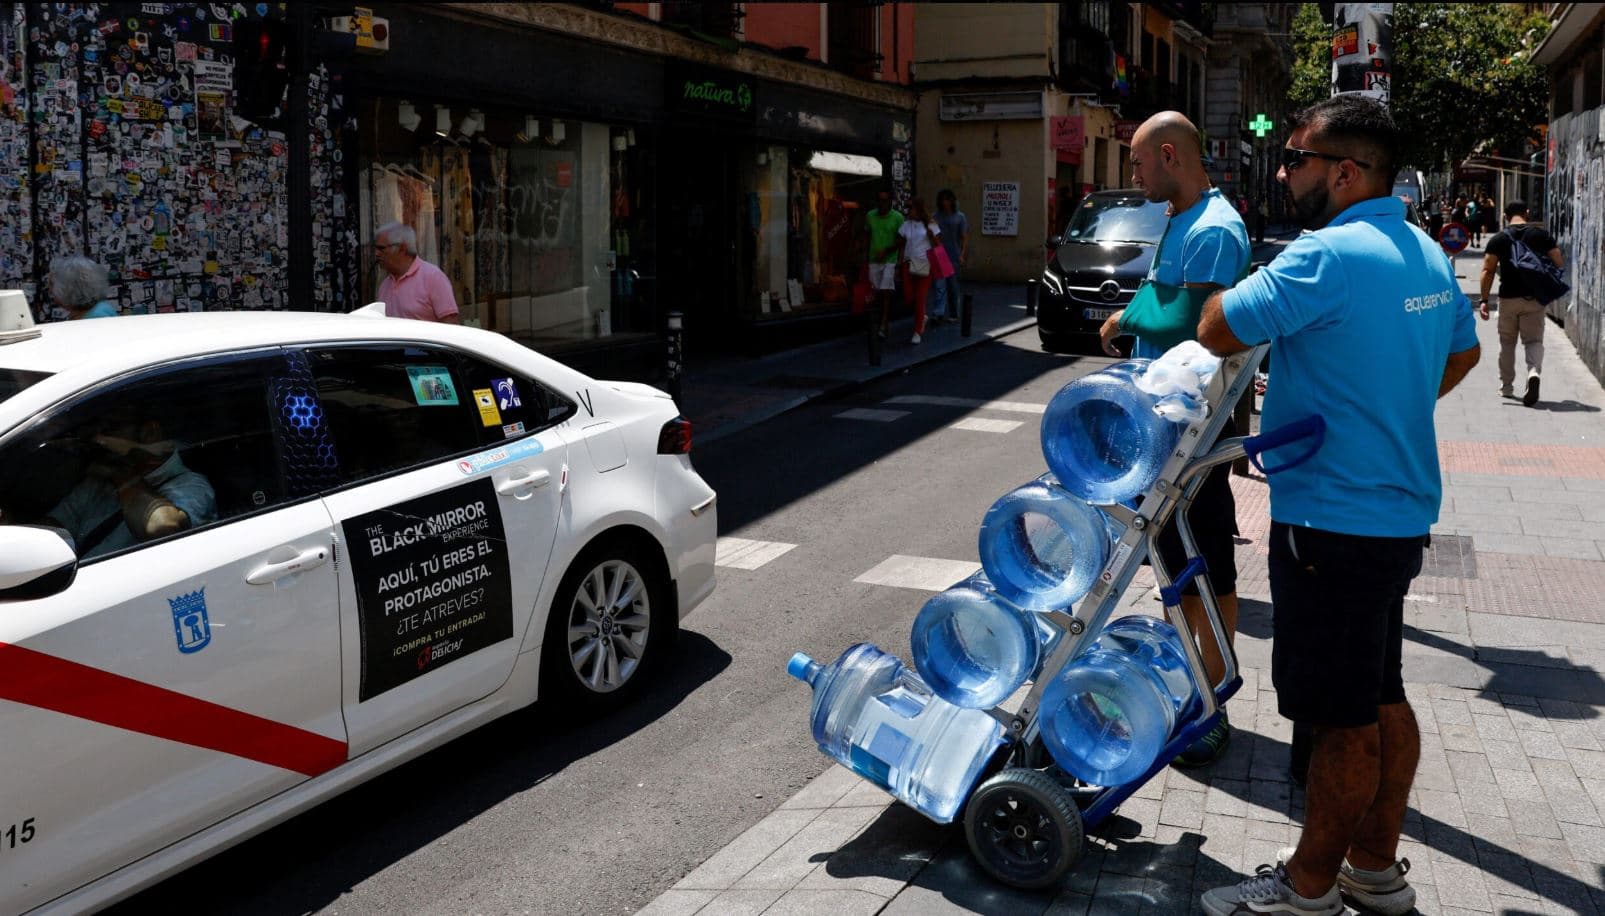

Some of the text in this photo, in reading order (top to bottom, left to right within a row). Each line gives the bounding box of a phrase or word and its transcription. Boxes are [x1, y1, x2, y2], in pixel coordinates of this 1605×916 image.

[683, 81, 736, 105] natura
[365, 524, 384, 538] THE
[369, 501, 486, 557] BLACK MIRROR
[442, 519, 489, 543] EXPERIENCE
[378, 540, 493, 594] AQUÍ, TÚ ERES EL
[384, 564, 492, 616] PROTAGONISTA.
[397, 588, 485, 635] ¿TE ATREVES?
[393, 611, 486, 656] ¡COMPRA TU ENTRADA!
[0, 817, 35, 851] 15
